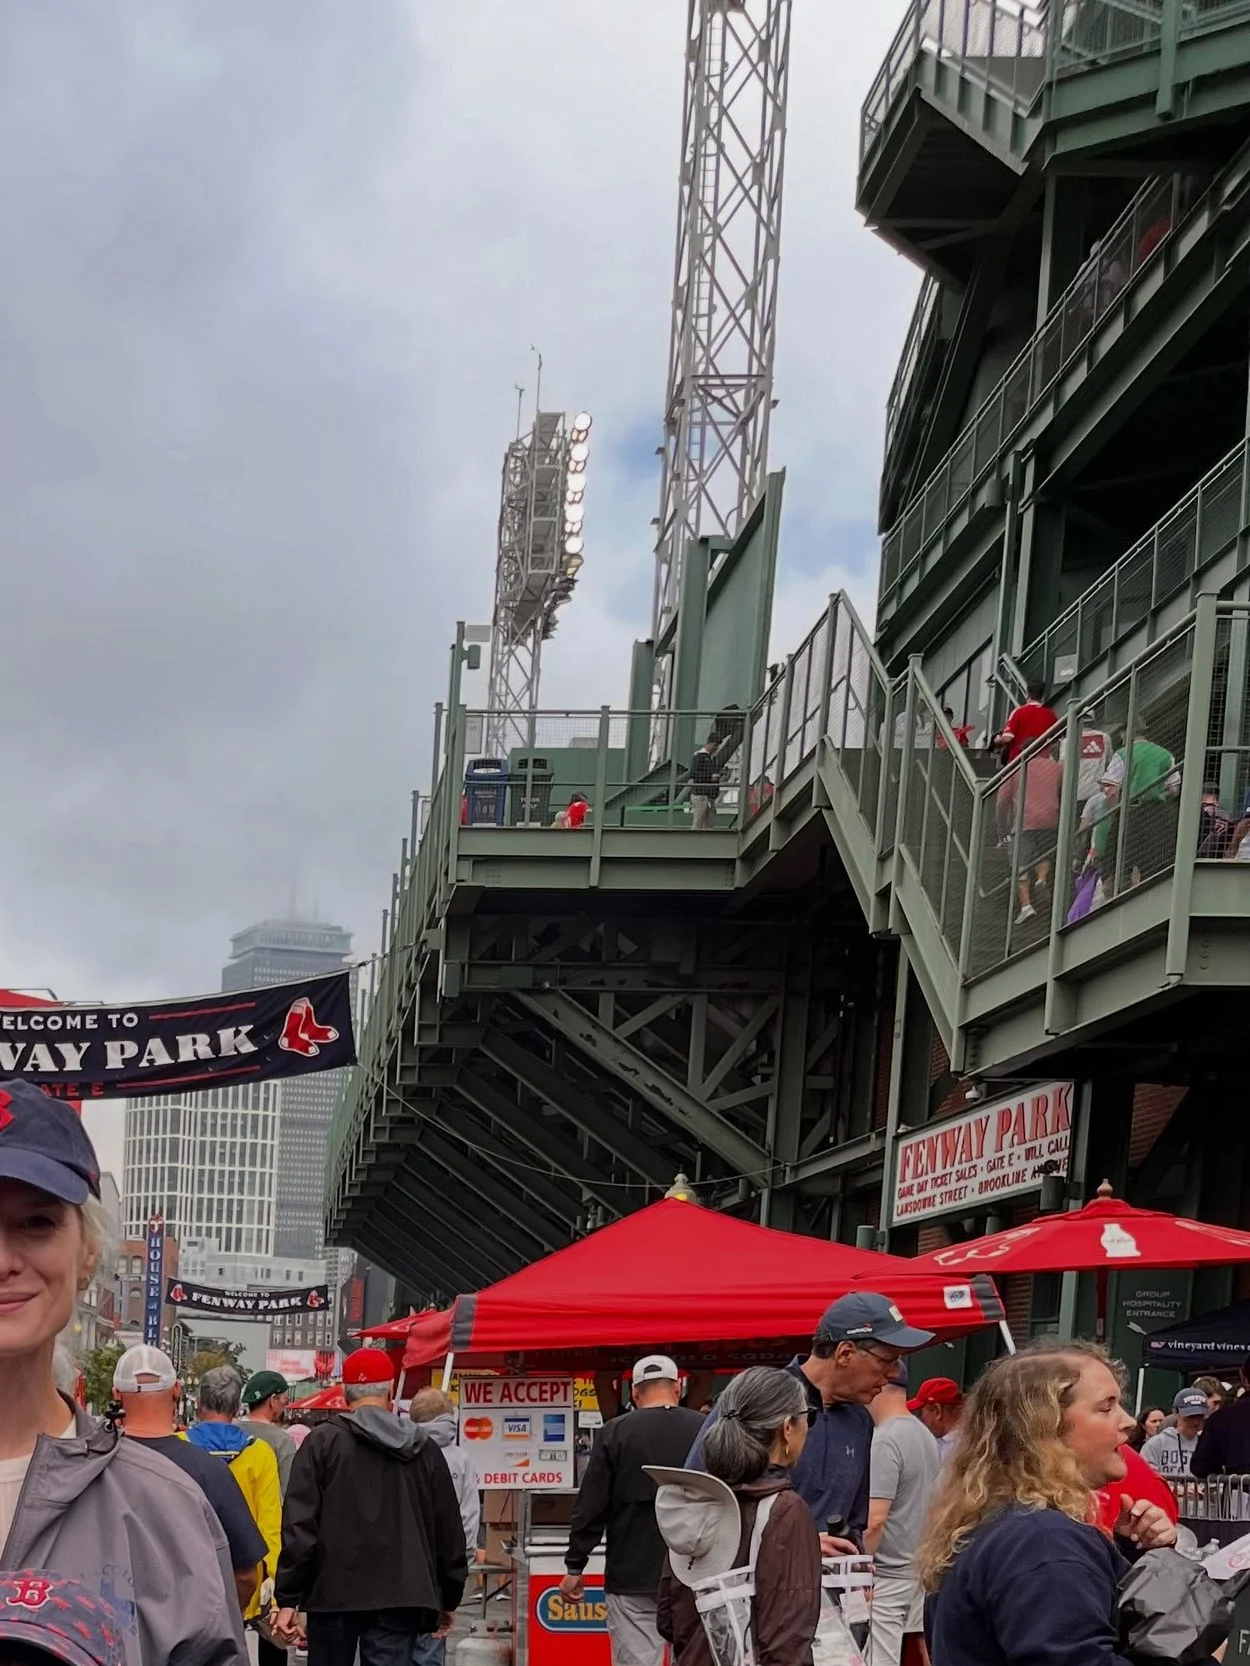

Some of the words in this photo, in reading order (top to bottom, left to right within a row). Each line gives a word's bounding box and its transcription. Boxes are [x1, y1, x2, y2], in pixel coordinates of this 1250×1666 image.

[108, 1012, 139, 1029] TO
[104, 1024, 259, 1070] PARK
[899, 1114, 991, 1184] FENWAY
[993, 1083, 1073, 1154] PARK
[930, 1171, 953, 1189] TICKET
[955, 1163, 979, 1183] SALES
[986, 1153, 1006, 1174] GATE
[1007, 1151, 1015, 1168] E
[1024, 1143, 1044, 1163] WILL
[1047, 1134, 1070, 1153] CALL
[896, 1193, 937, 1217] LANSDOWNE
[939, 1183, 969, 1206] STREET
[977, 1166, 1028, 1196] BROOKLINE
[150, 1237, 161, 1297] HOUSE
[192, 1292, 256, 1309] FENWAY
[258, 1297, 302, 1310] PARK
[225, 1290, 258, 1298] WELCOME
[1135, 1290, 1171, 1298] GROUP
[1122, 1300, 1182, 1309] HOSPITALITY
[1126, 1309, 1177, 1318] ENTRANCE
[1167, 1340, 1215, 1352] vineyard
[1216, 1342, 1245, 1351] vines
[464, 1381, 494, 1404] WE
[499, 1380, 571, 1404] ACCEPT
[507, 1423, 527, 1433] VISA
[484, 1472, 519, 1485] DEBIT
[522, 1471, 563, 1484] CARDS
[6, 1578, 54, 1609] B
[548, 1595, 609, 1621] Saus
